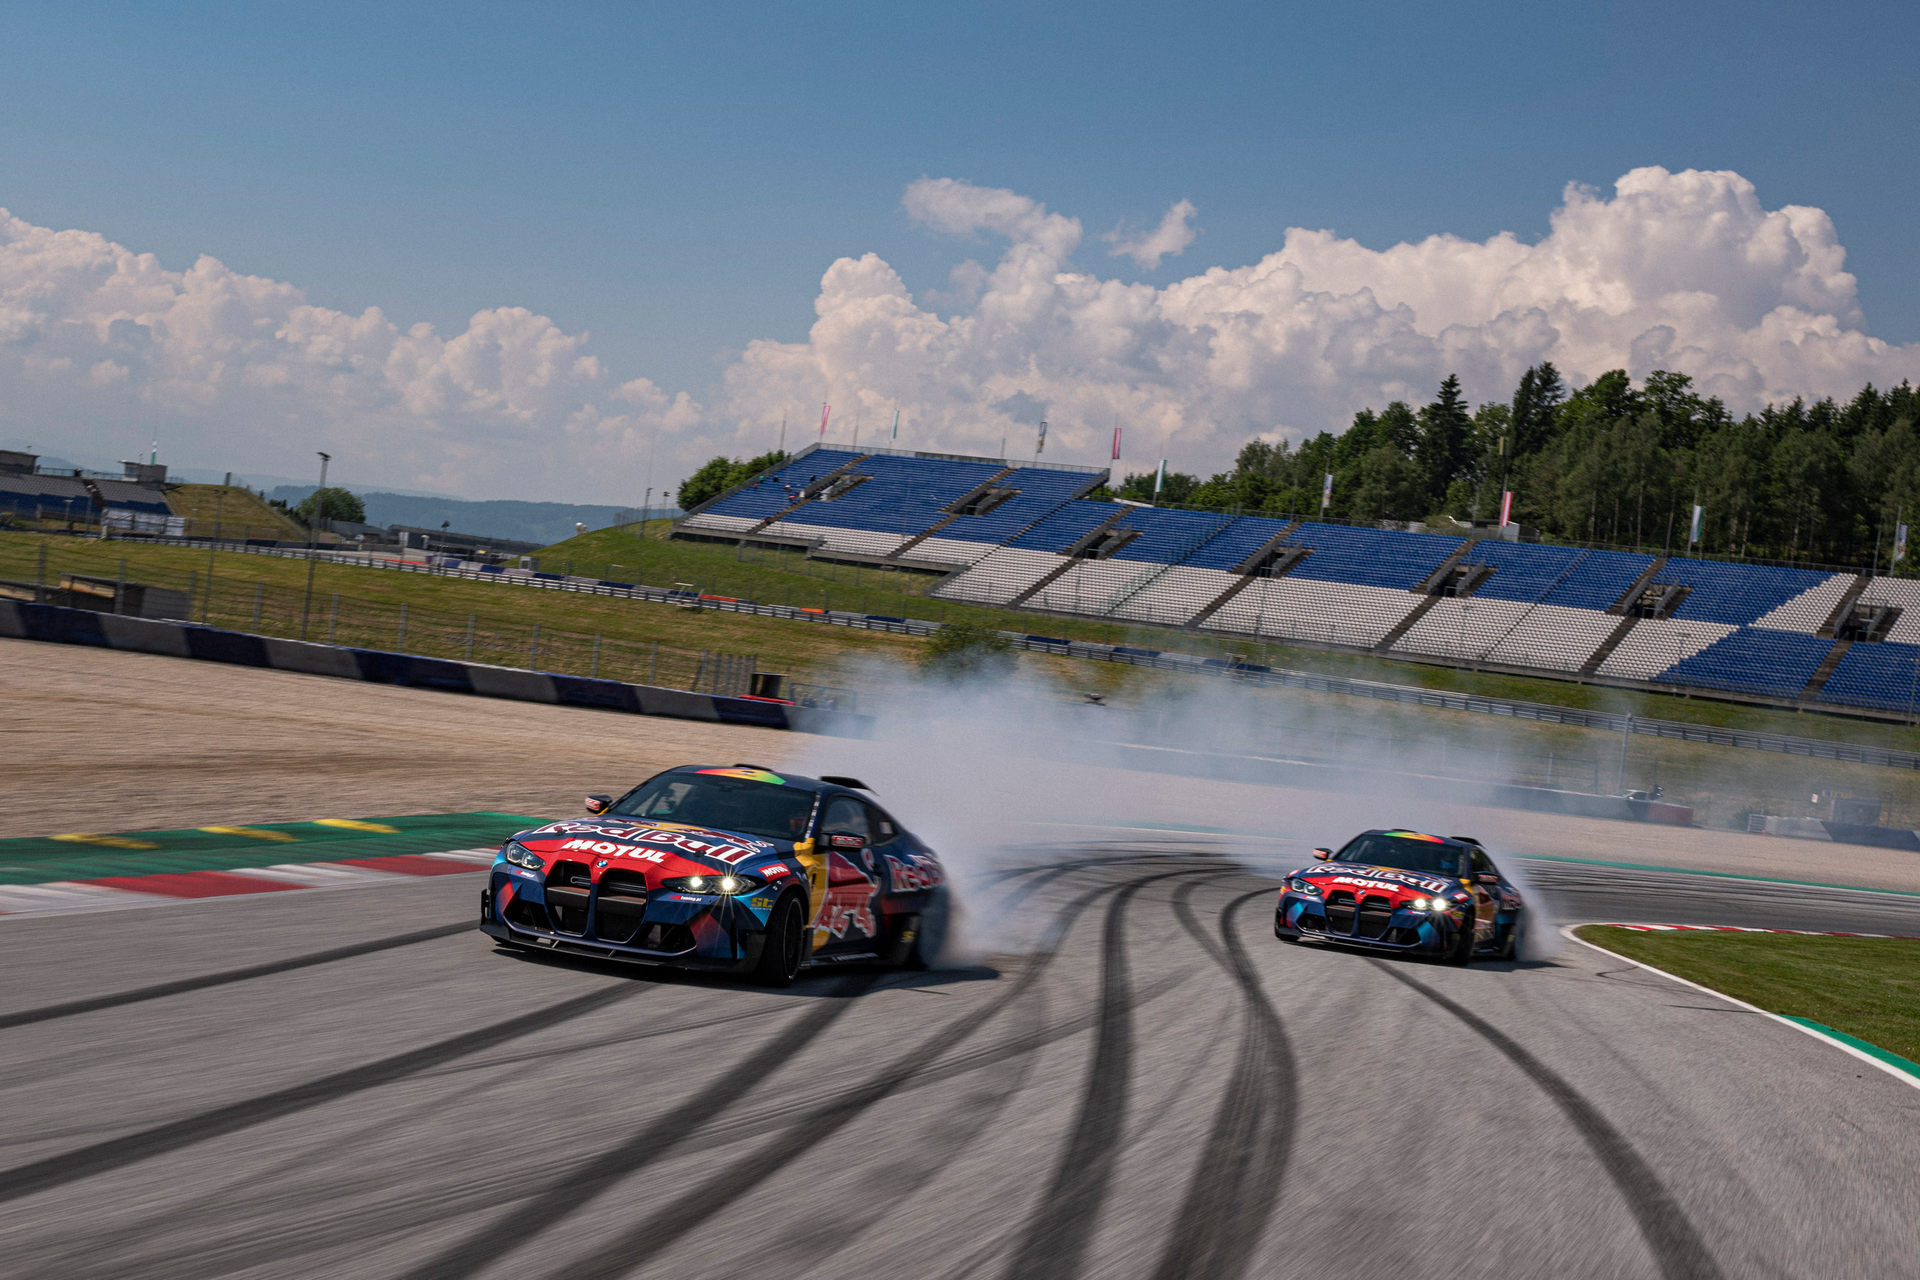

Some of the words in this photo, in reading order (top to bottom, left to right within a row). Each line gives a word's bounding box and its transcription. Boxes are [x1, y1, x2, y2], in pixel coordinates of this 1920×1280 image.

[532, 821, 638, 840] Red
[632, 829, 758, 865] Bull
[561, 839, 667, 863] MOTUL
[761, 866, 789, 877] MOTUL
[1306, 865, 1376, 878] Red
[1373, 870, 1451, 893] Bull
[1332, 876, 1400, 892] MOTUL
